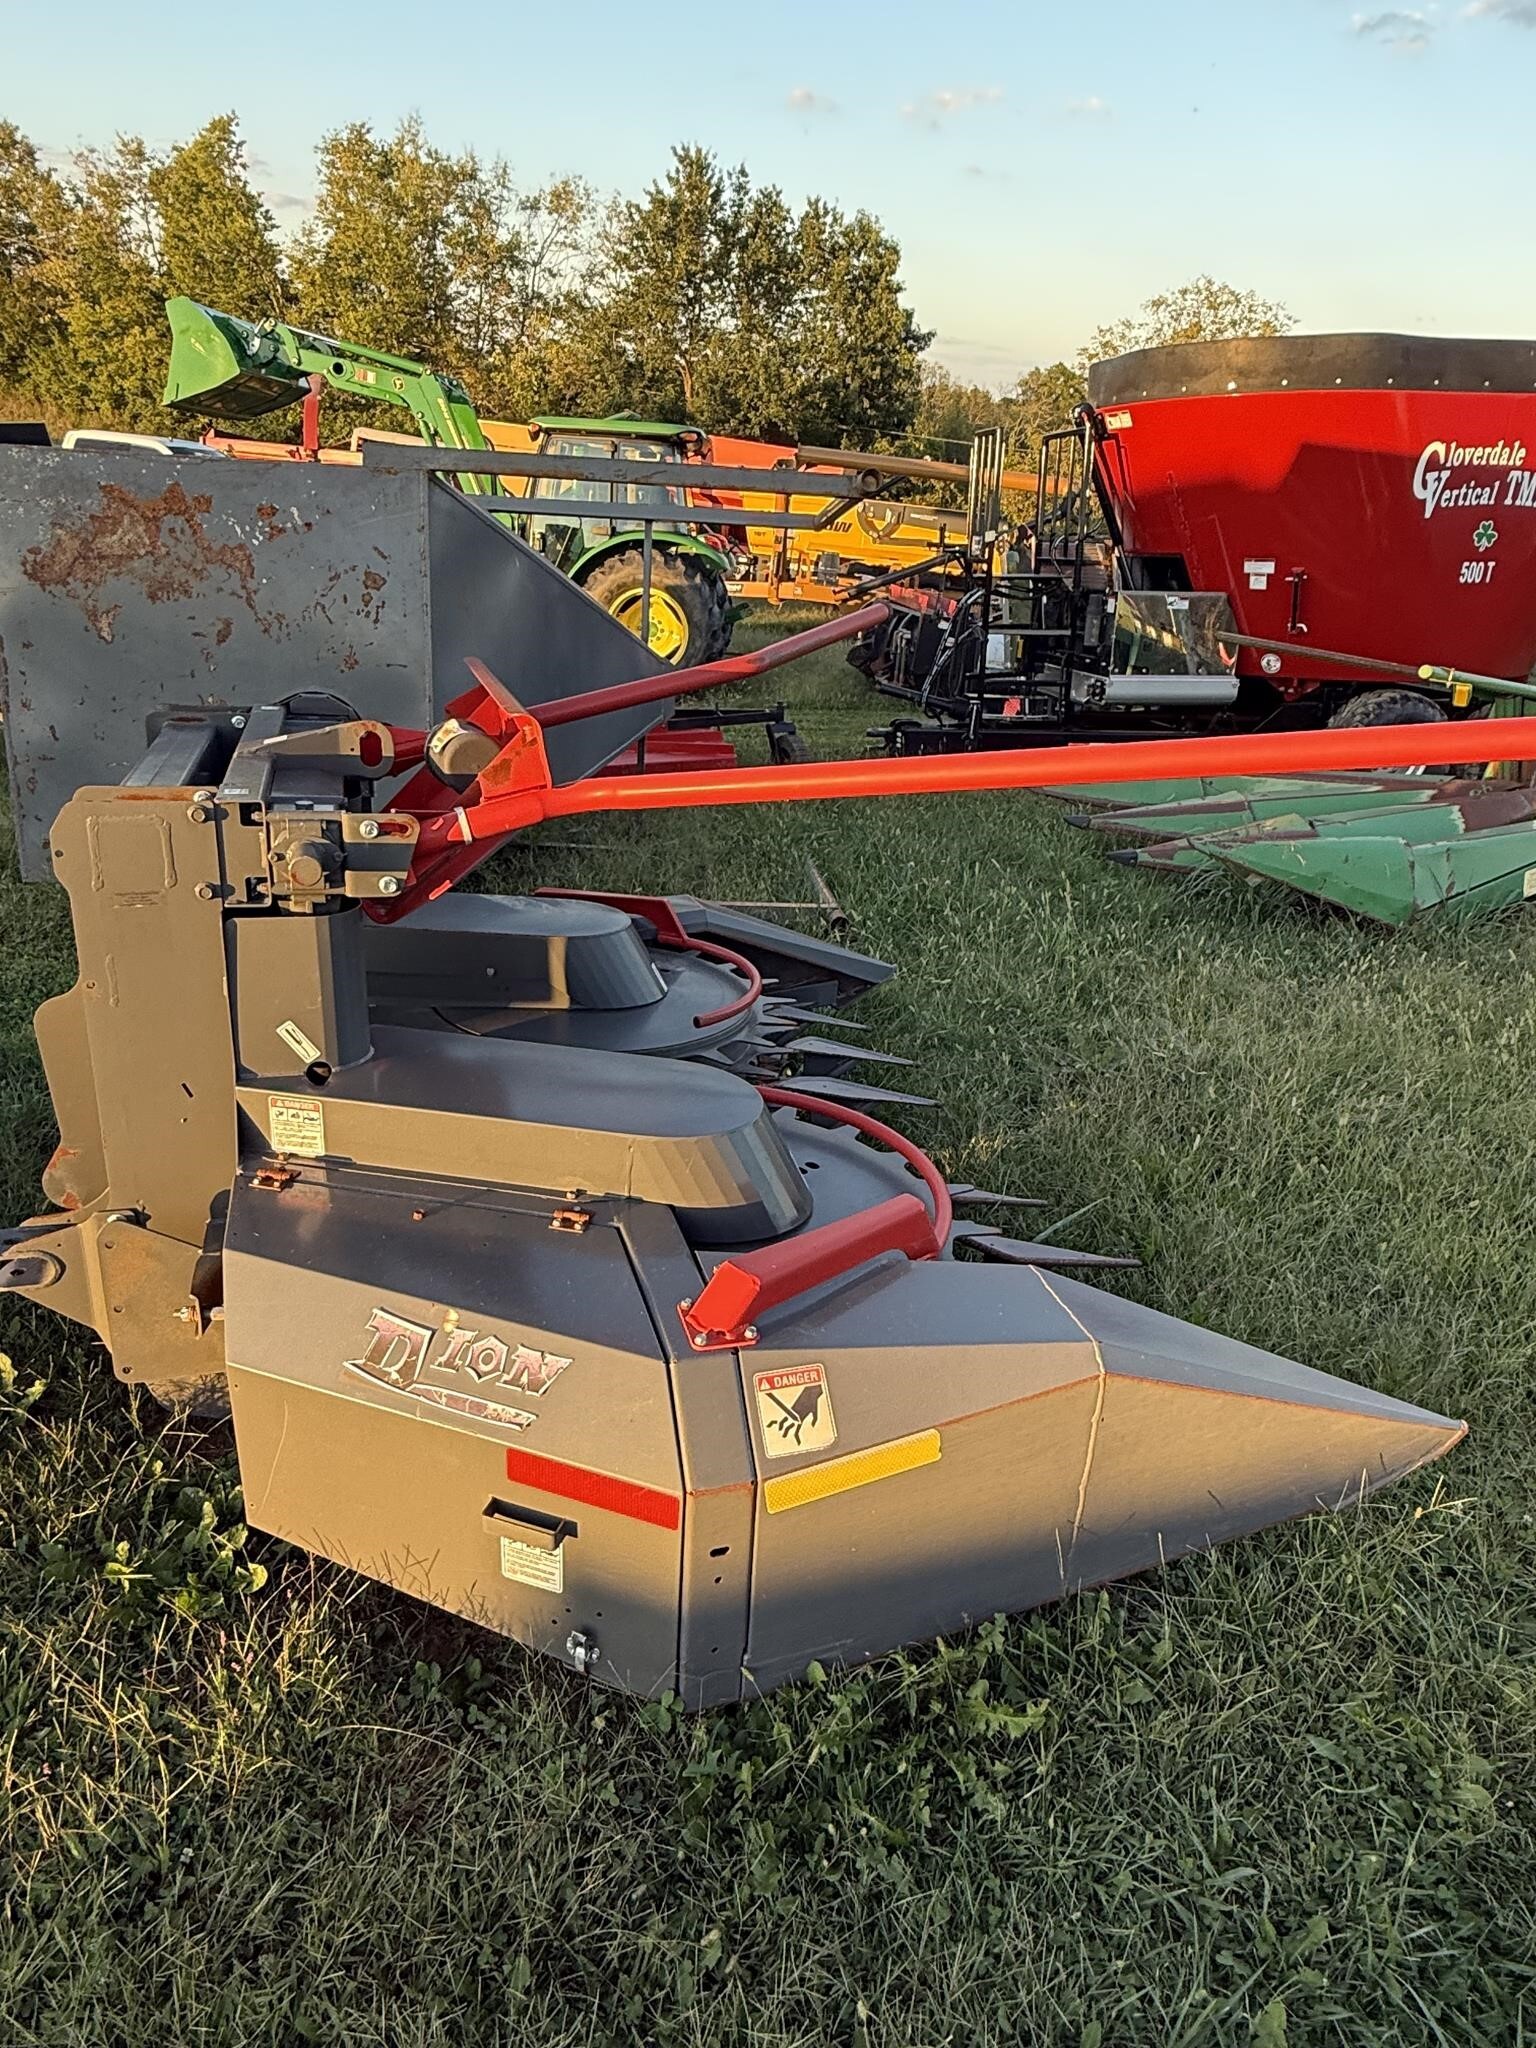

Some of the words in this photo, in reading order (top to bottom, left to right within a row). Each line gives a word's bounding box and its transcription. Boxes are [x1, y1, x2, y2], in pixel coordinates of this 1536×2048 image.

[1413, 440, 1526, 499] Cloverdale
[1424, 470, 1500, 518] Vertical
[1504, 469, 1536, 508] TM
[1459, 561, 1485, 583] 500
[1485, 561, 1496, 583] T
[343, 1307, 574, 1398] DION
[773, 1371, 819, 1388] DANGER
